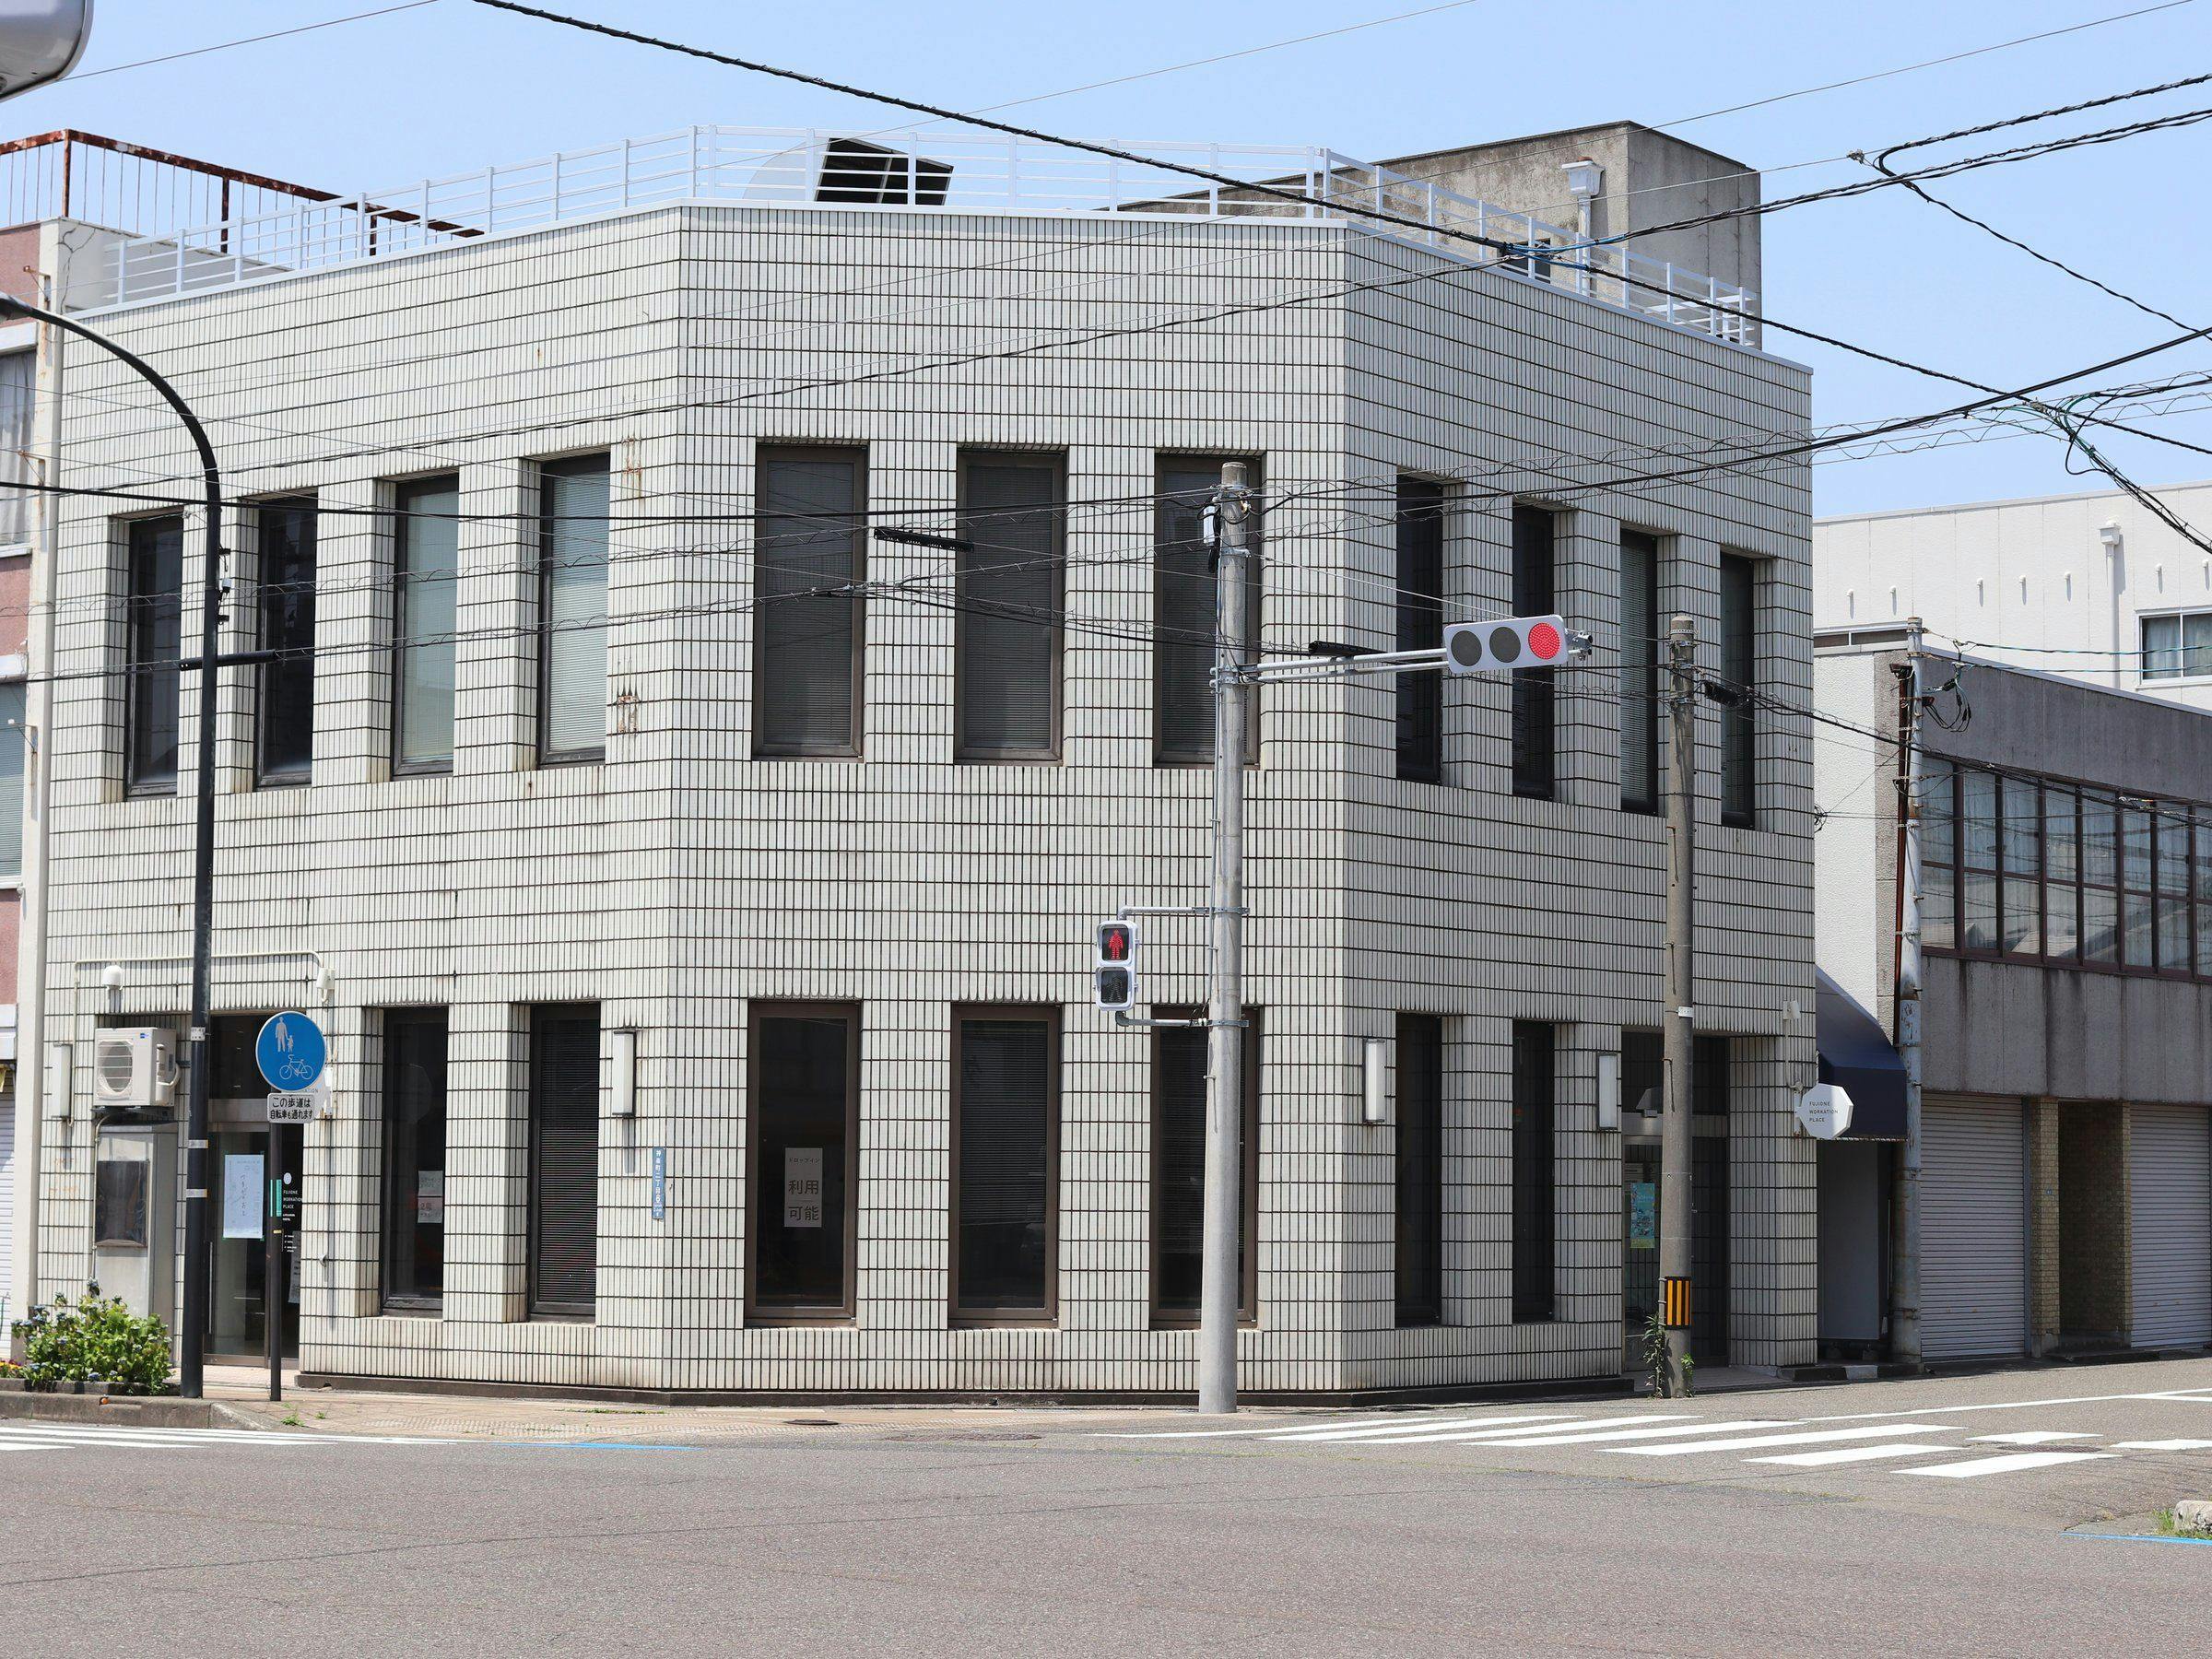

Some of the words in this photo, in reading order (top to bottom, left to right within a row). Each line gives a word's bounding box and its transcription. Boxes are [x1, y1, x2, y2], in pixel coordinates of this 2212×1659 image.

[272, 1097, 312, 1108] この歩道は
[270, 1109, 313, 1120] 自転車も通れます
[788, 1180, 819, 1194] 利用
[788, 1206, 819, 1221] 可能
